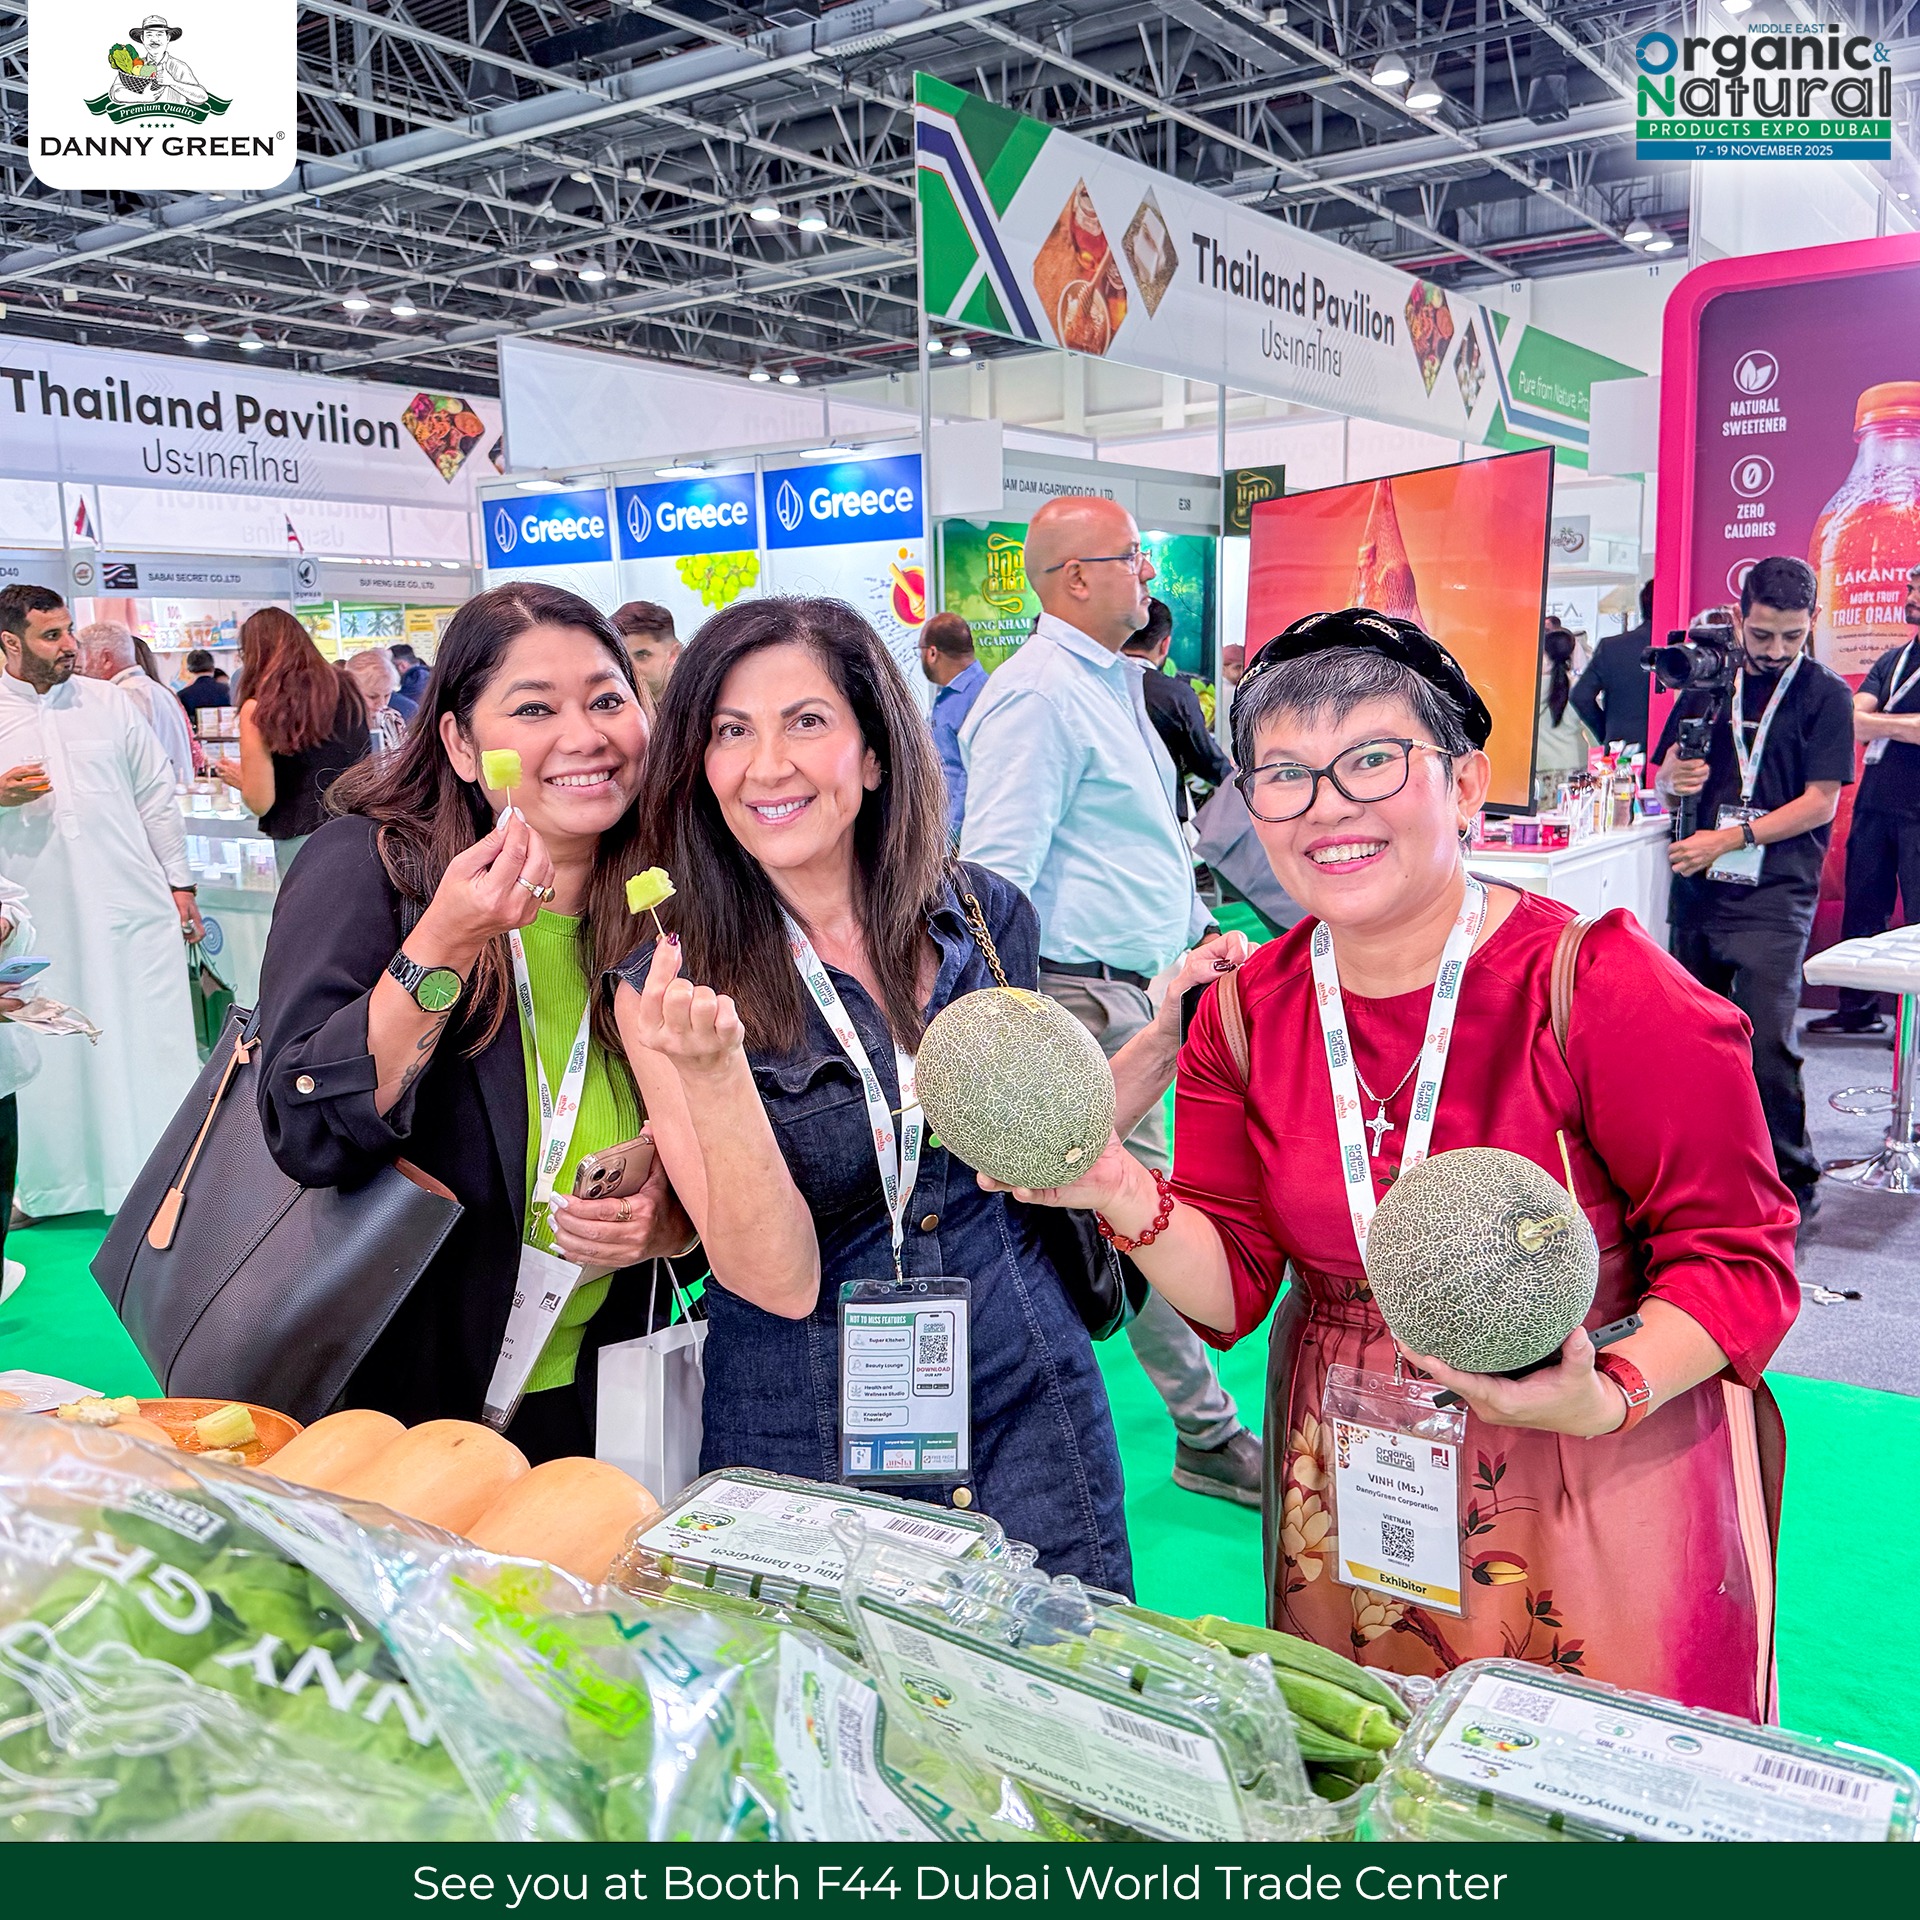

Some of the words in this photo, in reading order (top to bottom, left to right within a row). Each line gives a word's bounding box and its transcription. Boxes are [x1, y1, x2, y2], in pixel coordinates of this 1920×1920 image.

[1192, 232, 1306, 317] Thailand
[1312, 277, 1395, 346] Pavilion
[1262, 320, 1342, 378] ประเทศไทย
[1519, 370, 1535, 396] Pure
[1536, 376, 1553, 400] from
[0, 368, 223, 432] Thailand
[236, 394, 401, 450] Pavilion
[1730, 398, 1780, 416] NATURAL
[1722, 418, 1787, 437] SWEETENER
[142, 438, 300, 484] ประเทศไทย
[1020, 480, 1038, 494] DAM
[656, 500, 748, 533] Greece
[809, 486, 914, 520] Greece
[1736, 504, 1765, 519] ZERO
[520, 515, 604, 544] Greece
[1724, 522, 1776, 540] CALORIES
[148, 573, 174, 582] SABAI
[176, 573, 208, 582] SECRET
[394, 580, 406, 588] LEE
[1876, 590, 1900, 604] FRUIT
[998, 618, 1030, 630] KHAM
[1832, 608, 1862, 628] TRUE
[1866, 606, 1908, 624] ORAN
[979, 635, 1027, 646] AGARWO
[812, 974, 832, 1006] Natural
[817, 972, 835, 1004] Organic
[1438, 960, 1451, 998] Organic
[1444, 960, 1459, 998] Natural
[1330, 1030, 1342, 1068] Natural
[1336, 1028, 1348, 1065] Organic
[1414, 1081, 1426, 1120] Organic
[1420, 1081, 1433, 1122] Natural
[1348, 1145, 1360, 1184] Natural
[1355, 1144, 1366, 1182] Organic
[861, 1316, 868, 1324] TO
[868, 1316, 881, 1324] MISS
[882, 1316, 906, 1324] FEATURES
[1376, 1447, 1414, 1460] Organic
[1376, 1454, 1414, 1469] Natural
[1356, 1485, 1396, 1502] DannyGreen
[1398, 1496, 1438, 1512] Corporation
[1368, 1473, 1394, 1488] VINH
[1398, 1481, 1424, 1496] (Ms.)
[1383, 1513, 1412, 1526] VIETNAM
[710, 1547, 792, 1570] DannyGreen
[820, 1560, 844, 1569] KRA
[1380, 1573, 1427, 1594] Exhibitor
[985, 1744, 1084, 1792] DannyGreen
[1534, 1780, 1659, 1826] DannyGreen
